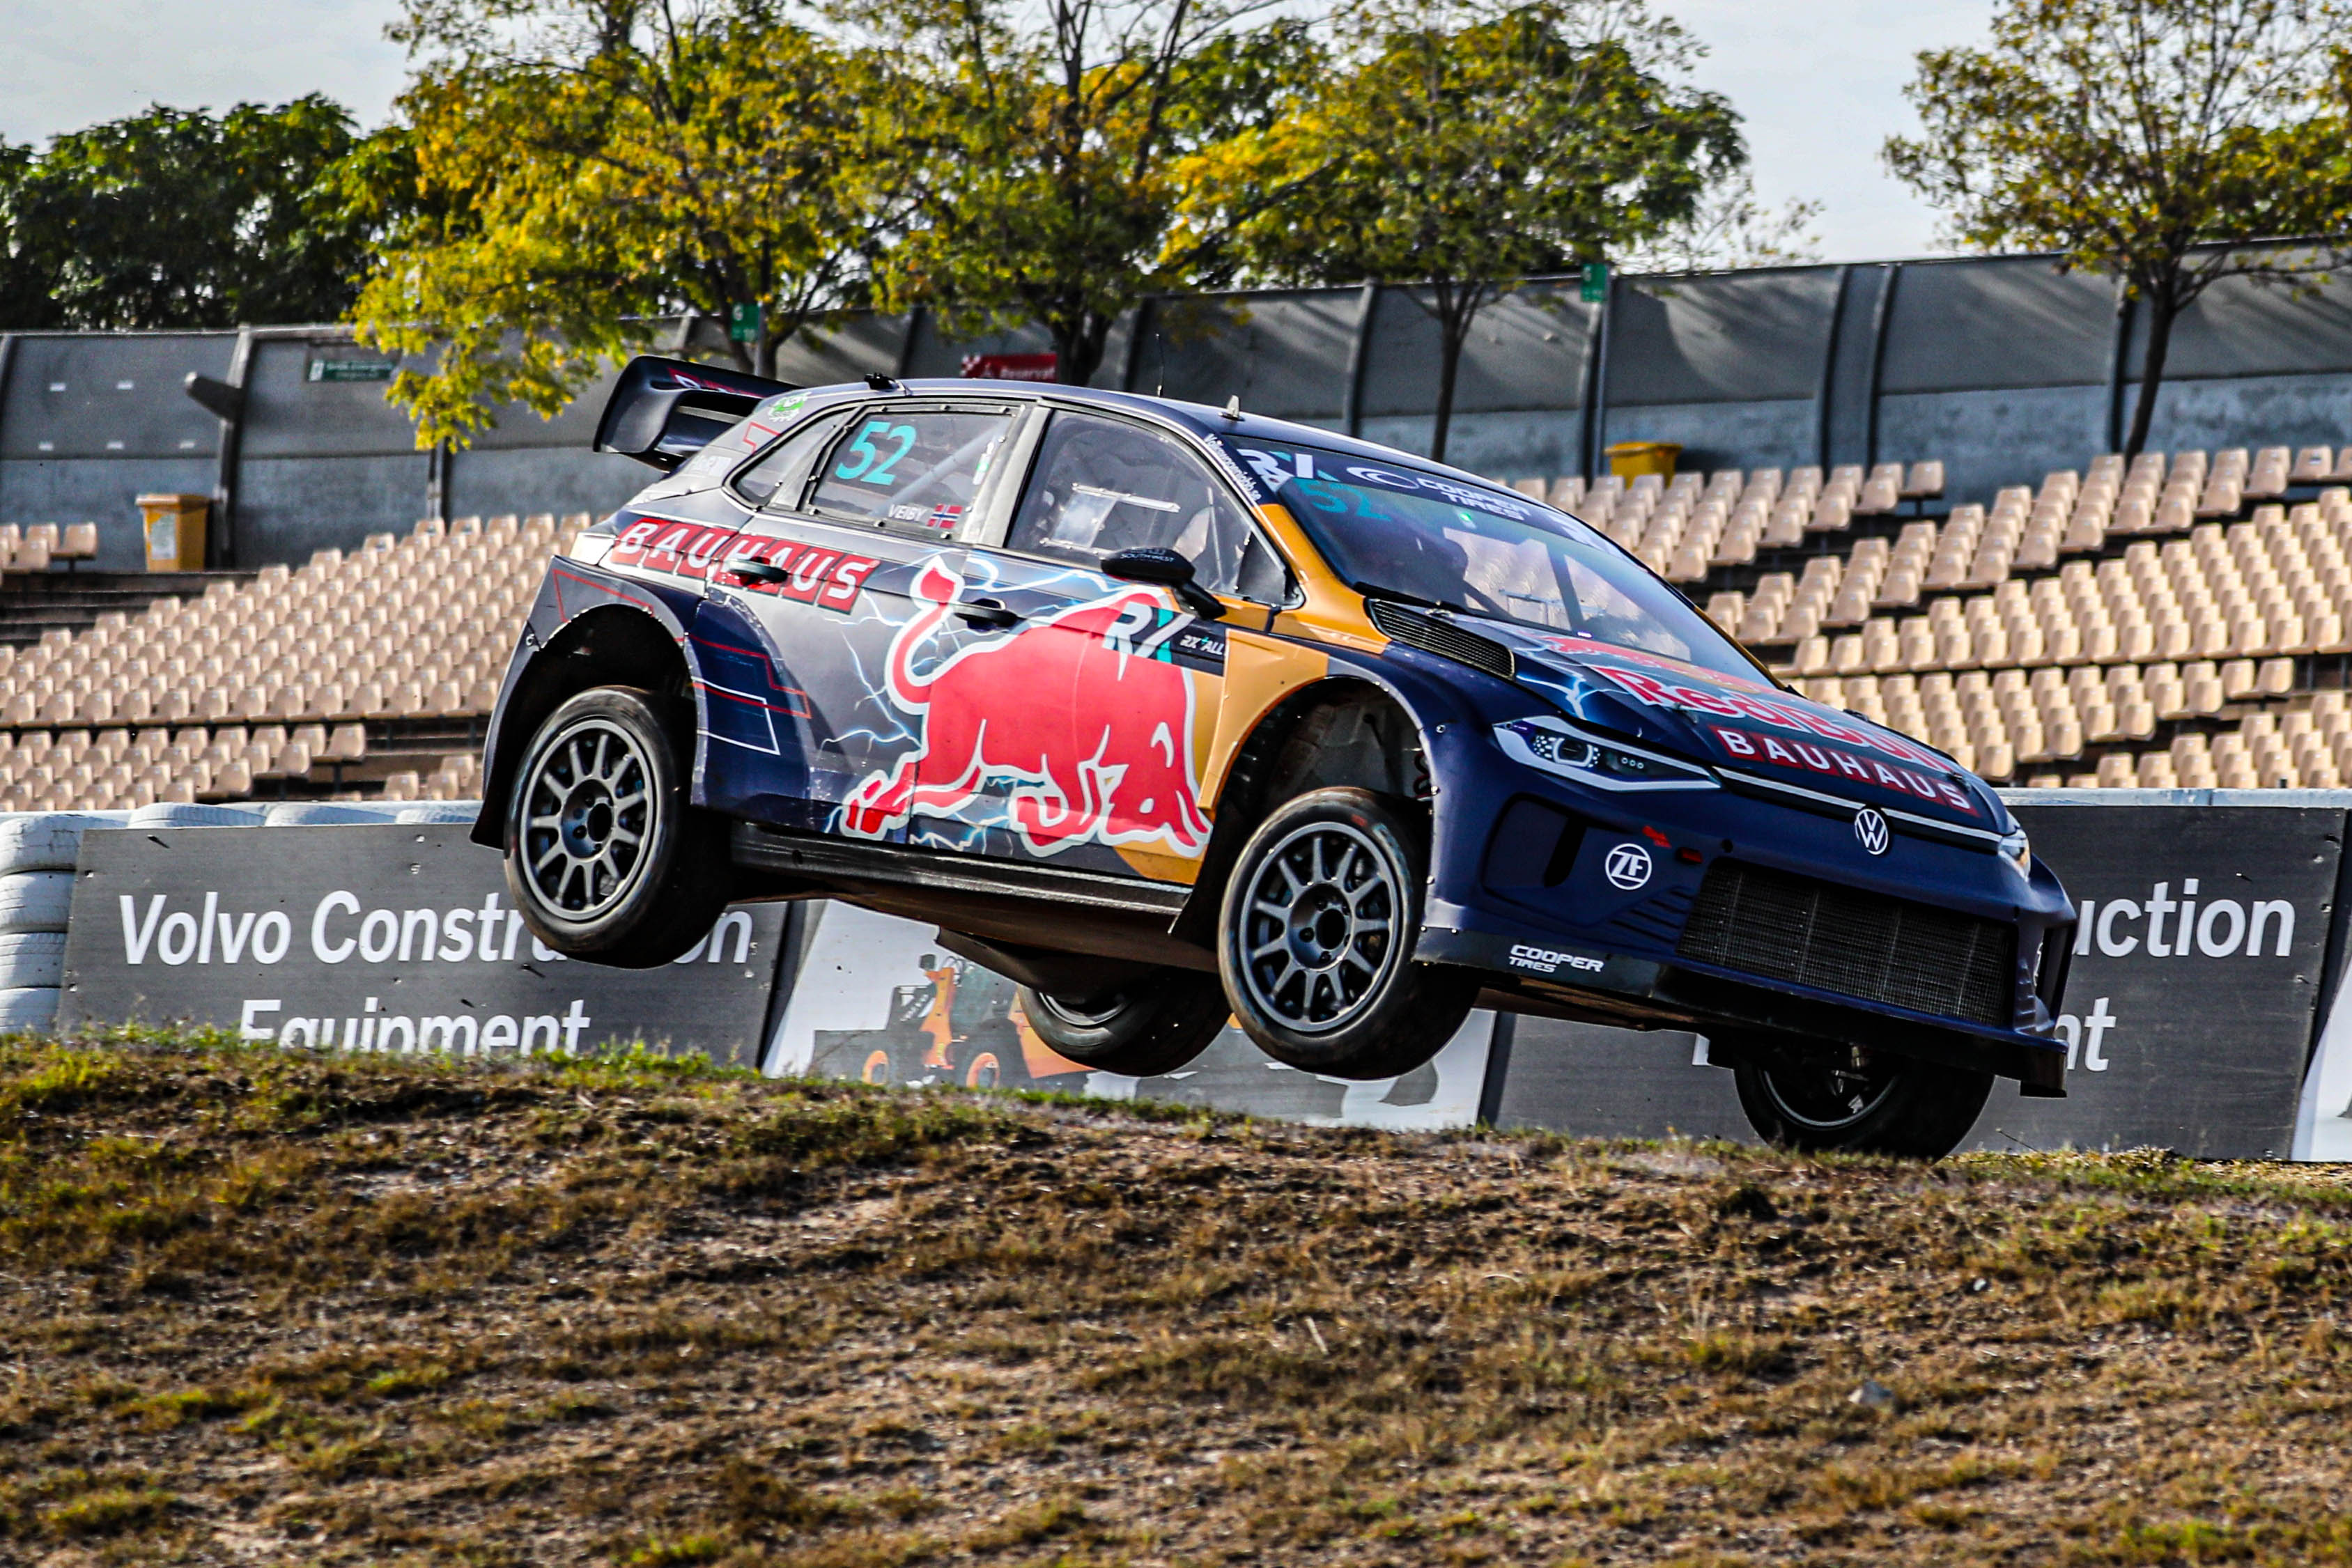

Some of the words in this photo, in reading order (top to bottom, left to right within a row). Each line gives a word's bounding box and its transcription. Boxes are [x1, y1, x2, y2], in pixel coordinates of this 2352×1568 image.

[835, 421, 917, 486] 52
[888, 504, 927, 522] VEIBY
[1416, 478, 1531, 516] COOPER
[1441, 491, 1524, 520] TIRES
[1588, 666, 1810, 733] Red
[1718, 730, 1972, 810] BAUHAUS
[1608, 847, 1650, 887] ZF
[118, 892, 291, 965] Volvo
[1508, 956, 1557, 972] TIRES
[1510, 945, 1604, 972] COOPER
